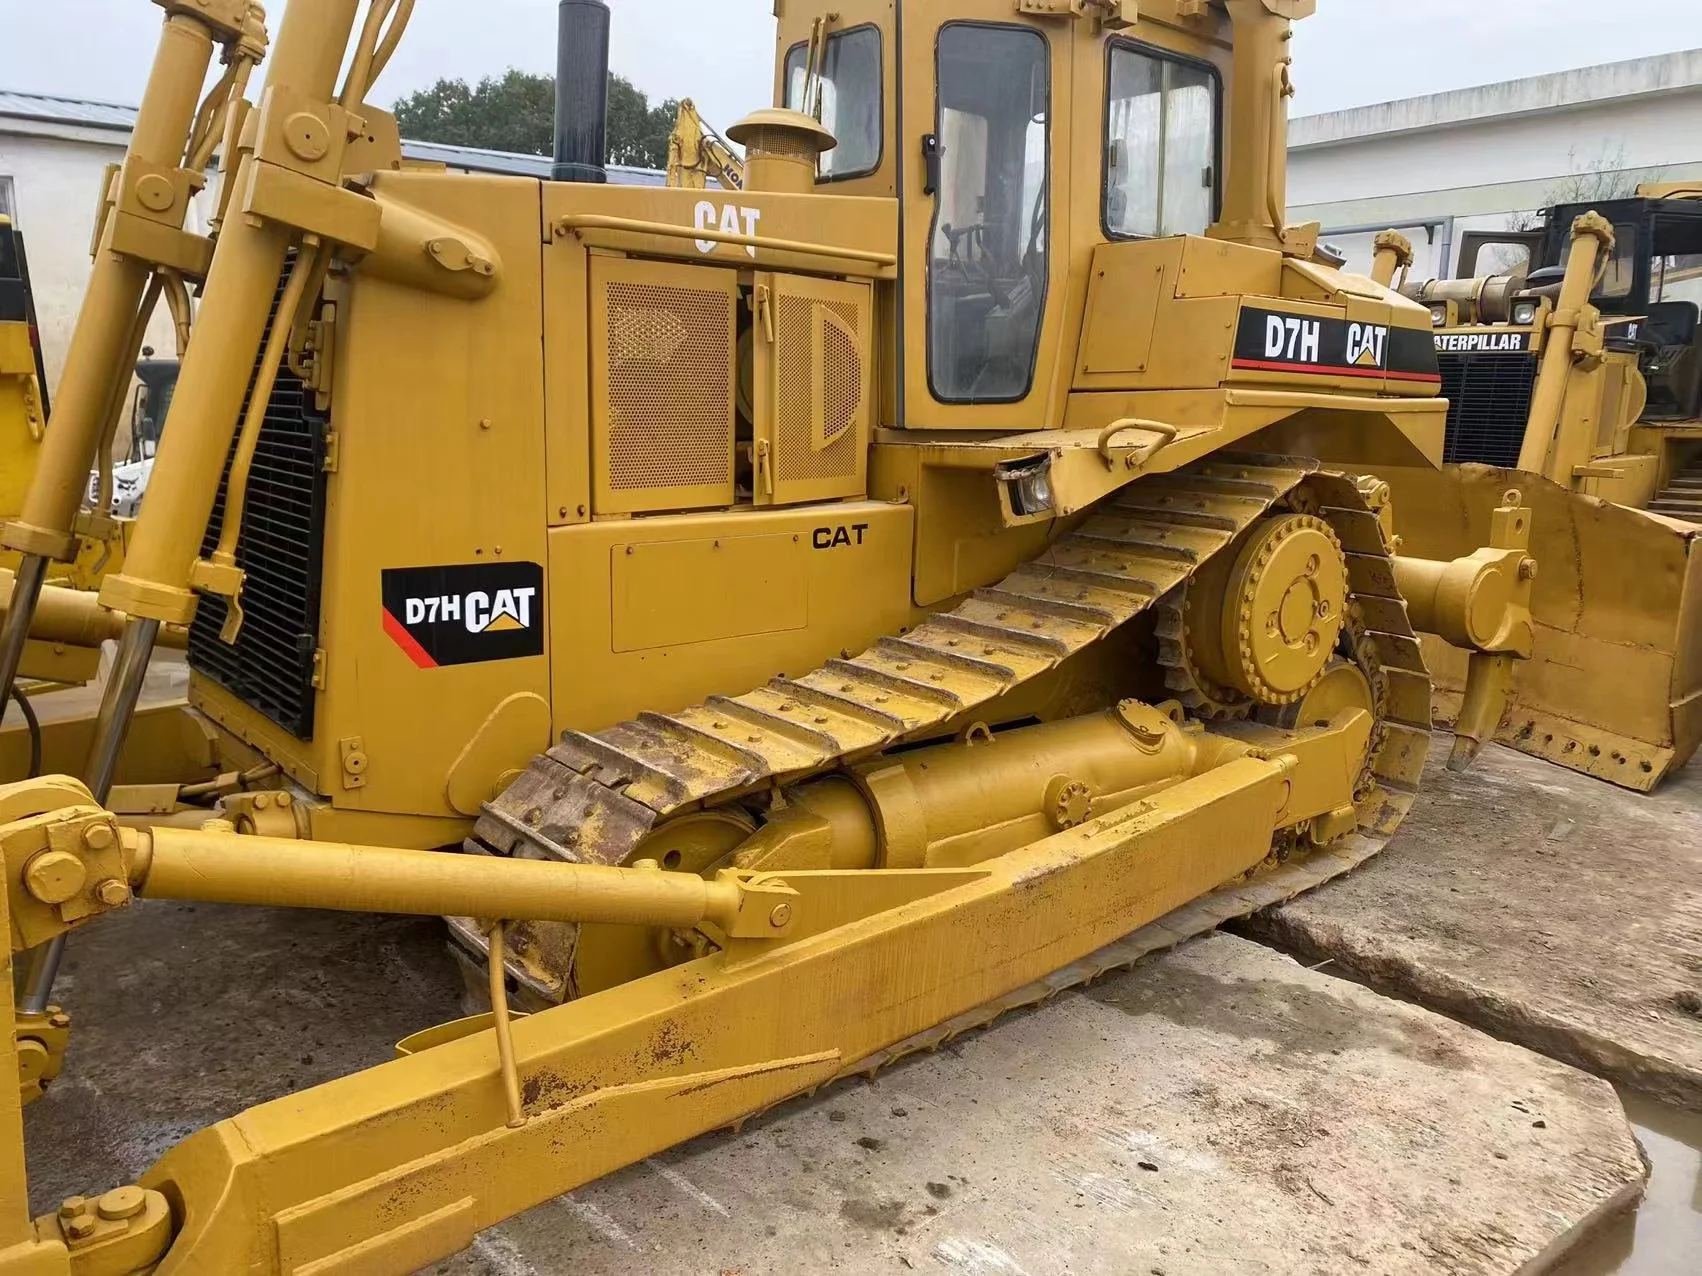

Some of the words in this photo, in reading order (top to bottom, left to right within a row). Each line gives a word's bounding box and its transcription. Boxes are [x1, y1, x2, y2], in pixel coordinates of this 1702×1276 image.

[694, 200, 760, 258] CAT
[1265, 315, 1320, 362] D7H
[1346, 323, 1386, 366] CAT
[1434, 334, 1521, 351] ATERPILLAR
[813, 523, 868, 549] CAT
[406, 595, 460, 625] D7H
[465, 587, 535, 633] CAT
